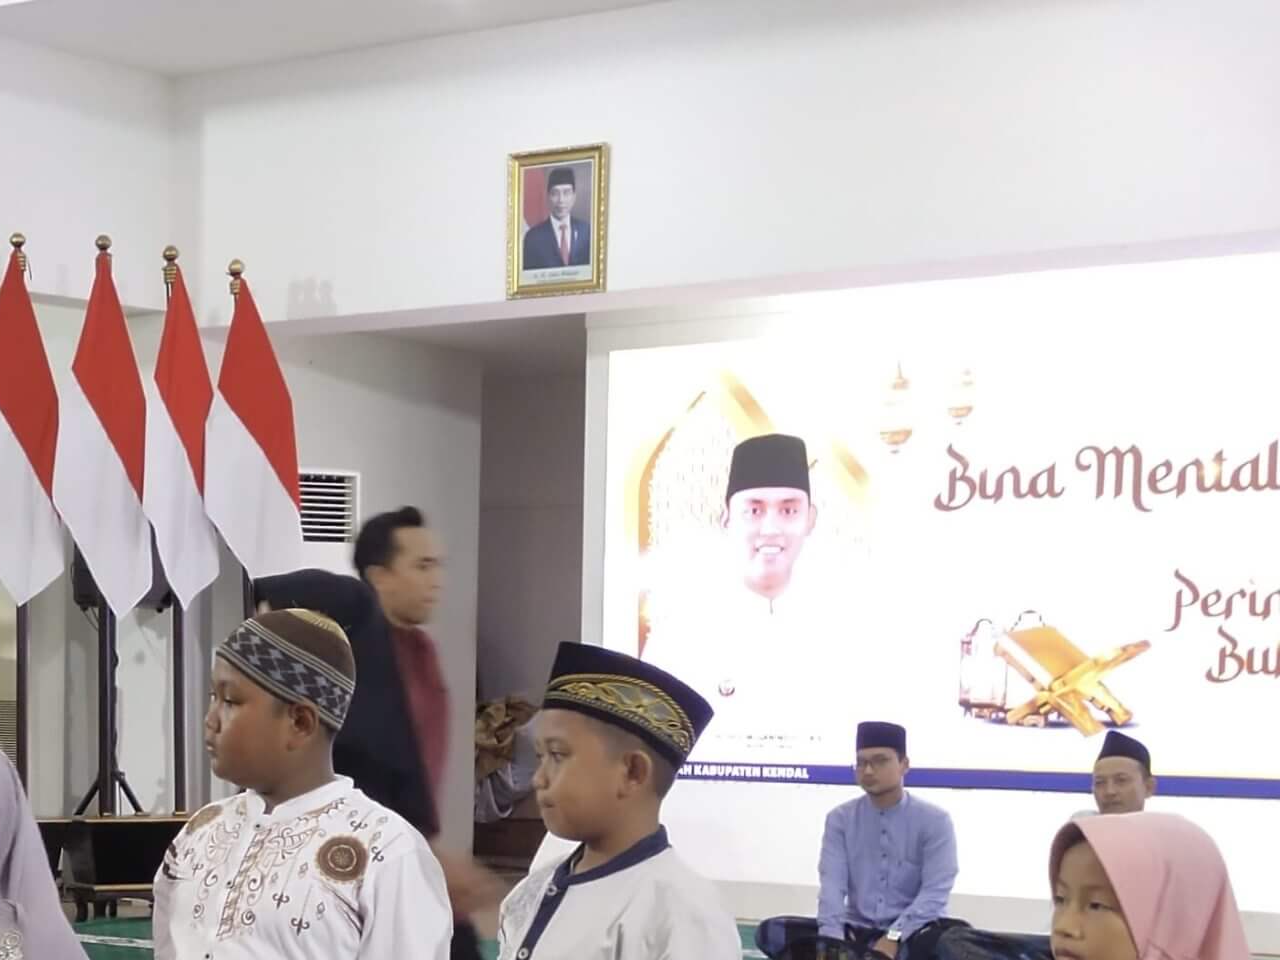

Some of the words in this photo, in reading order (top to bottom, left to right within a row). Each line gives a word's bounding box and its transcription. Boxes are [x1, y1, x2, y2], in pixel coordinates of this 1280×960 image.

[933, 442, 1065, 512] Bina
[1075, 439, 1280, 513] Mental
[694, 764, 761, 777] KABUPATEN
[762, 766, 810, 779] KENDAL
